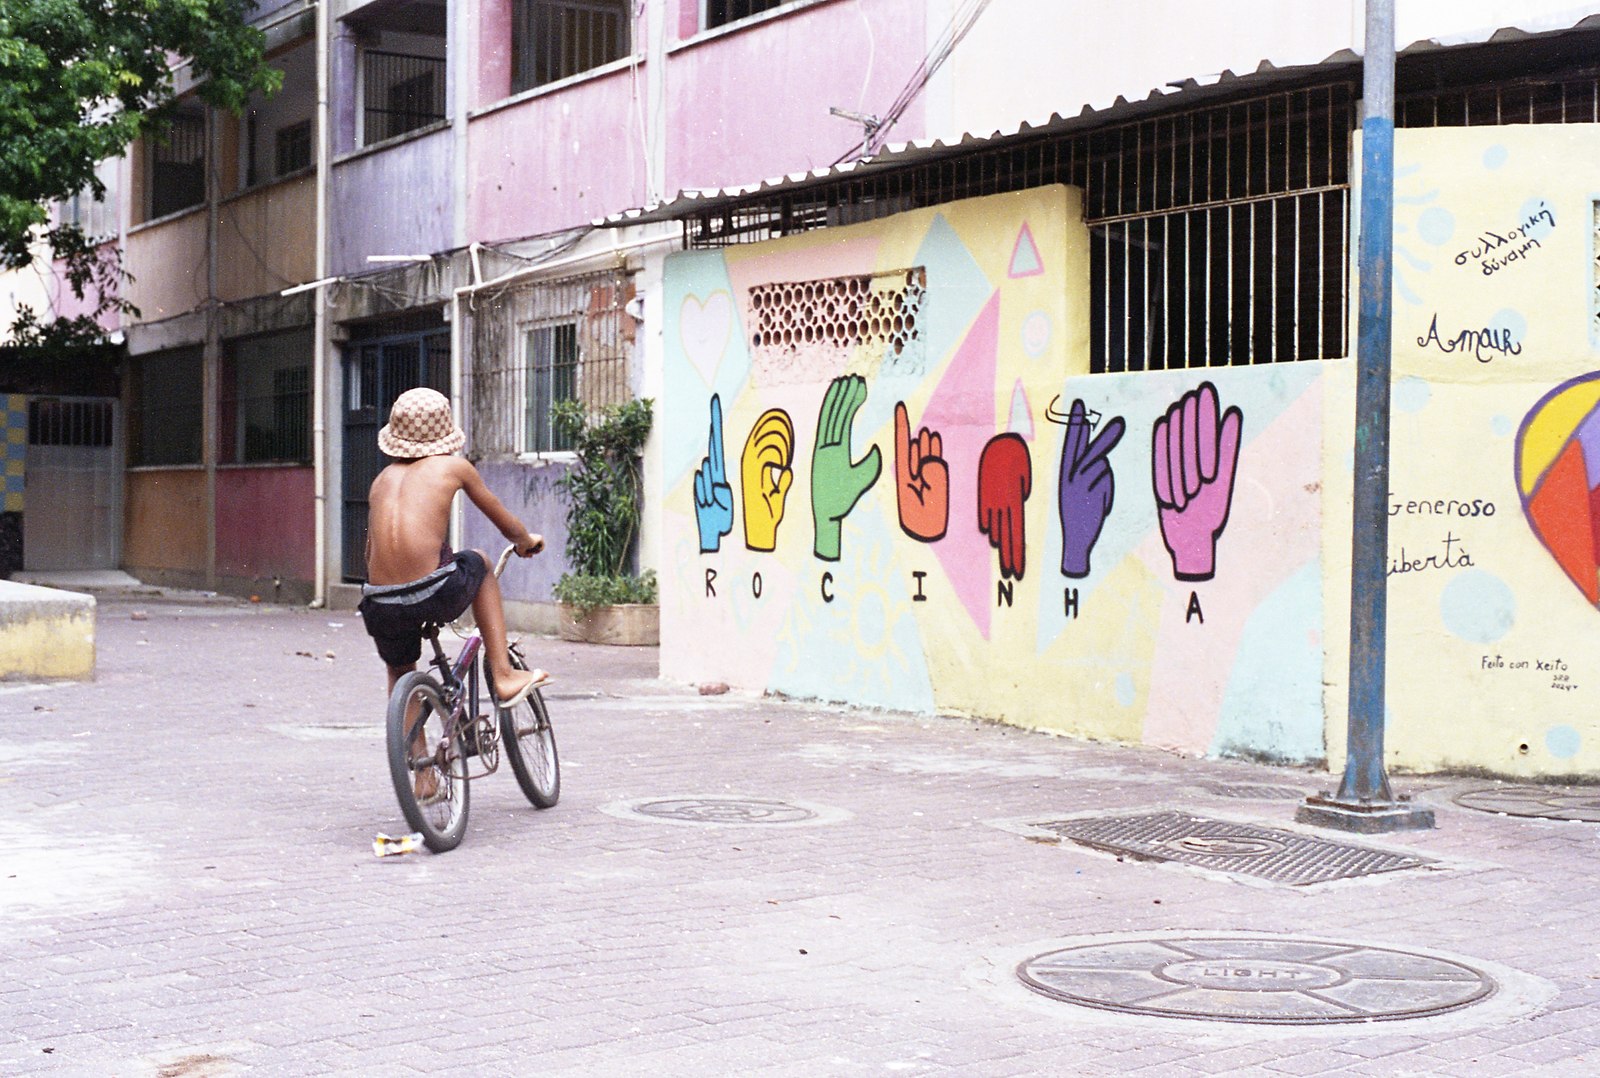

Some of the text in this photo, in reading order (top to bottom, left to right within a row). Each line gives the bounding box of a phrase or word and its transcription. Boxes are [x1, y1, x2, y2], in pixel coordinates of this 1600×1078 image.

[1454, 201, 1556, 266] συλλογική
[1481, 238, 1541, 276] δύναμη
[1387, 531, 1475, 576] ibertà
[1509, 660, 1529, 669] con
[1203, 968, 1301, 979] LIGHT
